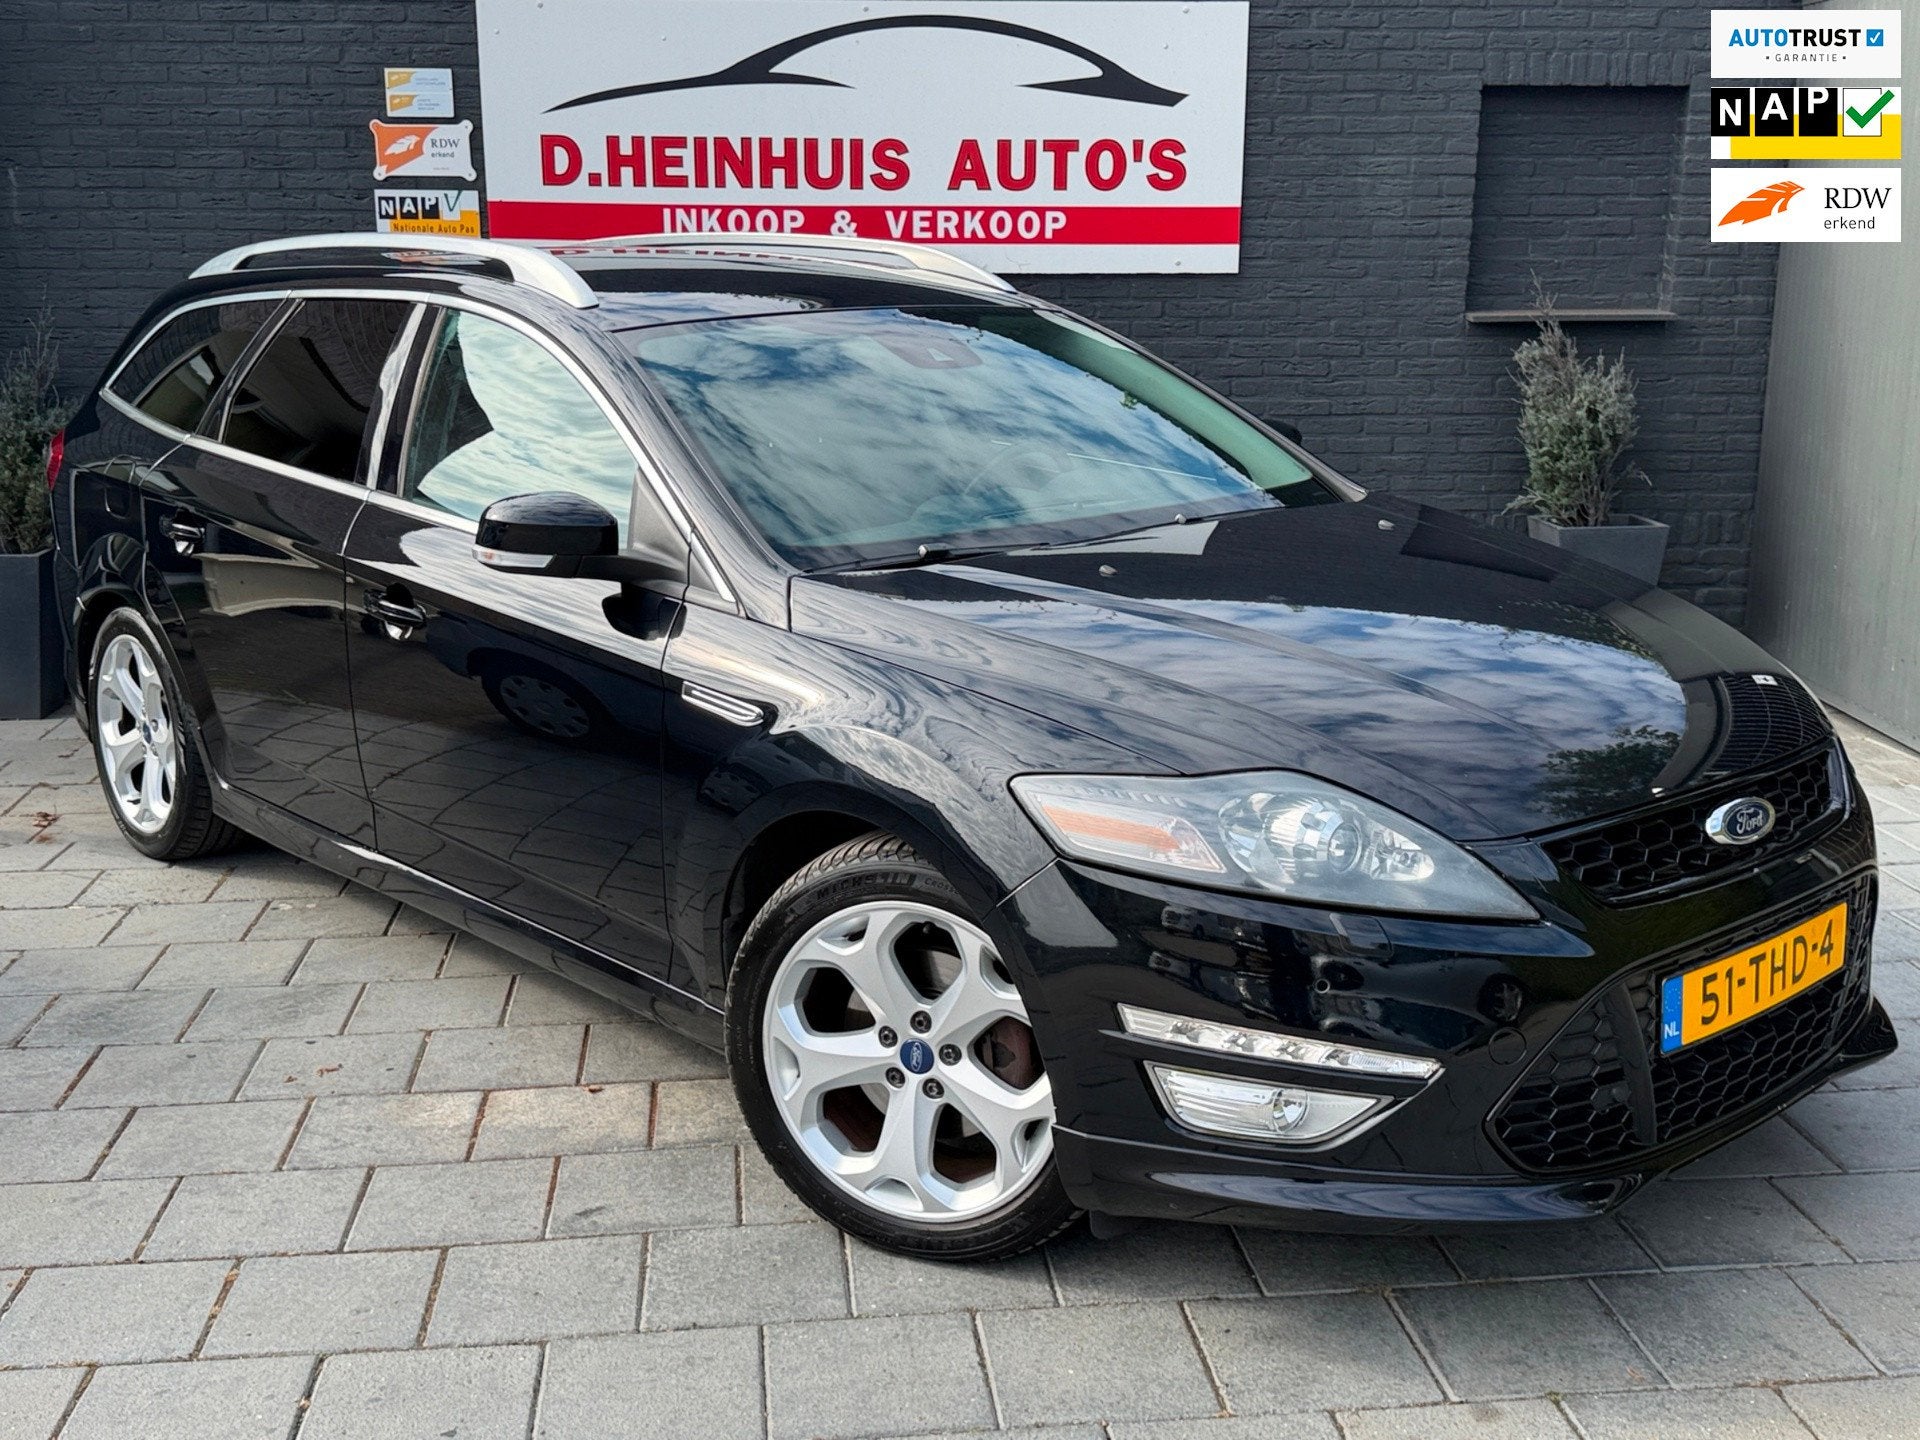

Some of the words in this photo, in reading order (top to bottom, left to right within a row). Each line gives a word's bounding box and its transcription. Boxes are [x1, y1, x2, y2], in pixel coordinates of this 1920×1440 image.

[430, 138, 460, 149] RDW
[539, 133, 911, 191] D.HEINHUIS
[947, 138, 1187, 192] AUTO'S
[380, 196, 437, 216] NAP
[393, 222, 435, 233] Nationale
[438, 223, 457, 234] Auto
[459, 224, 475, 234] Pas
[662, 208, 806, 234] INKOOP
[830, 210, 858, 237] &
[885, 210, 1067, 240] VERKOOP
[1735, 806, 1764, 835] Ford
[1700, 918, 1834, 1026] 51-THD-4
[1664, 1022, 1680, 1039] NL
